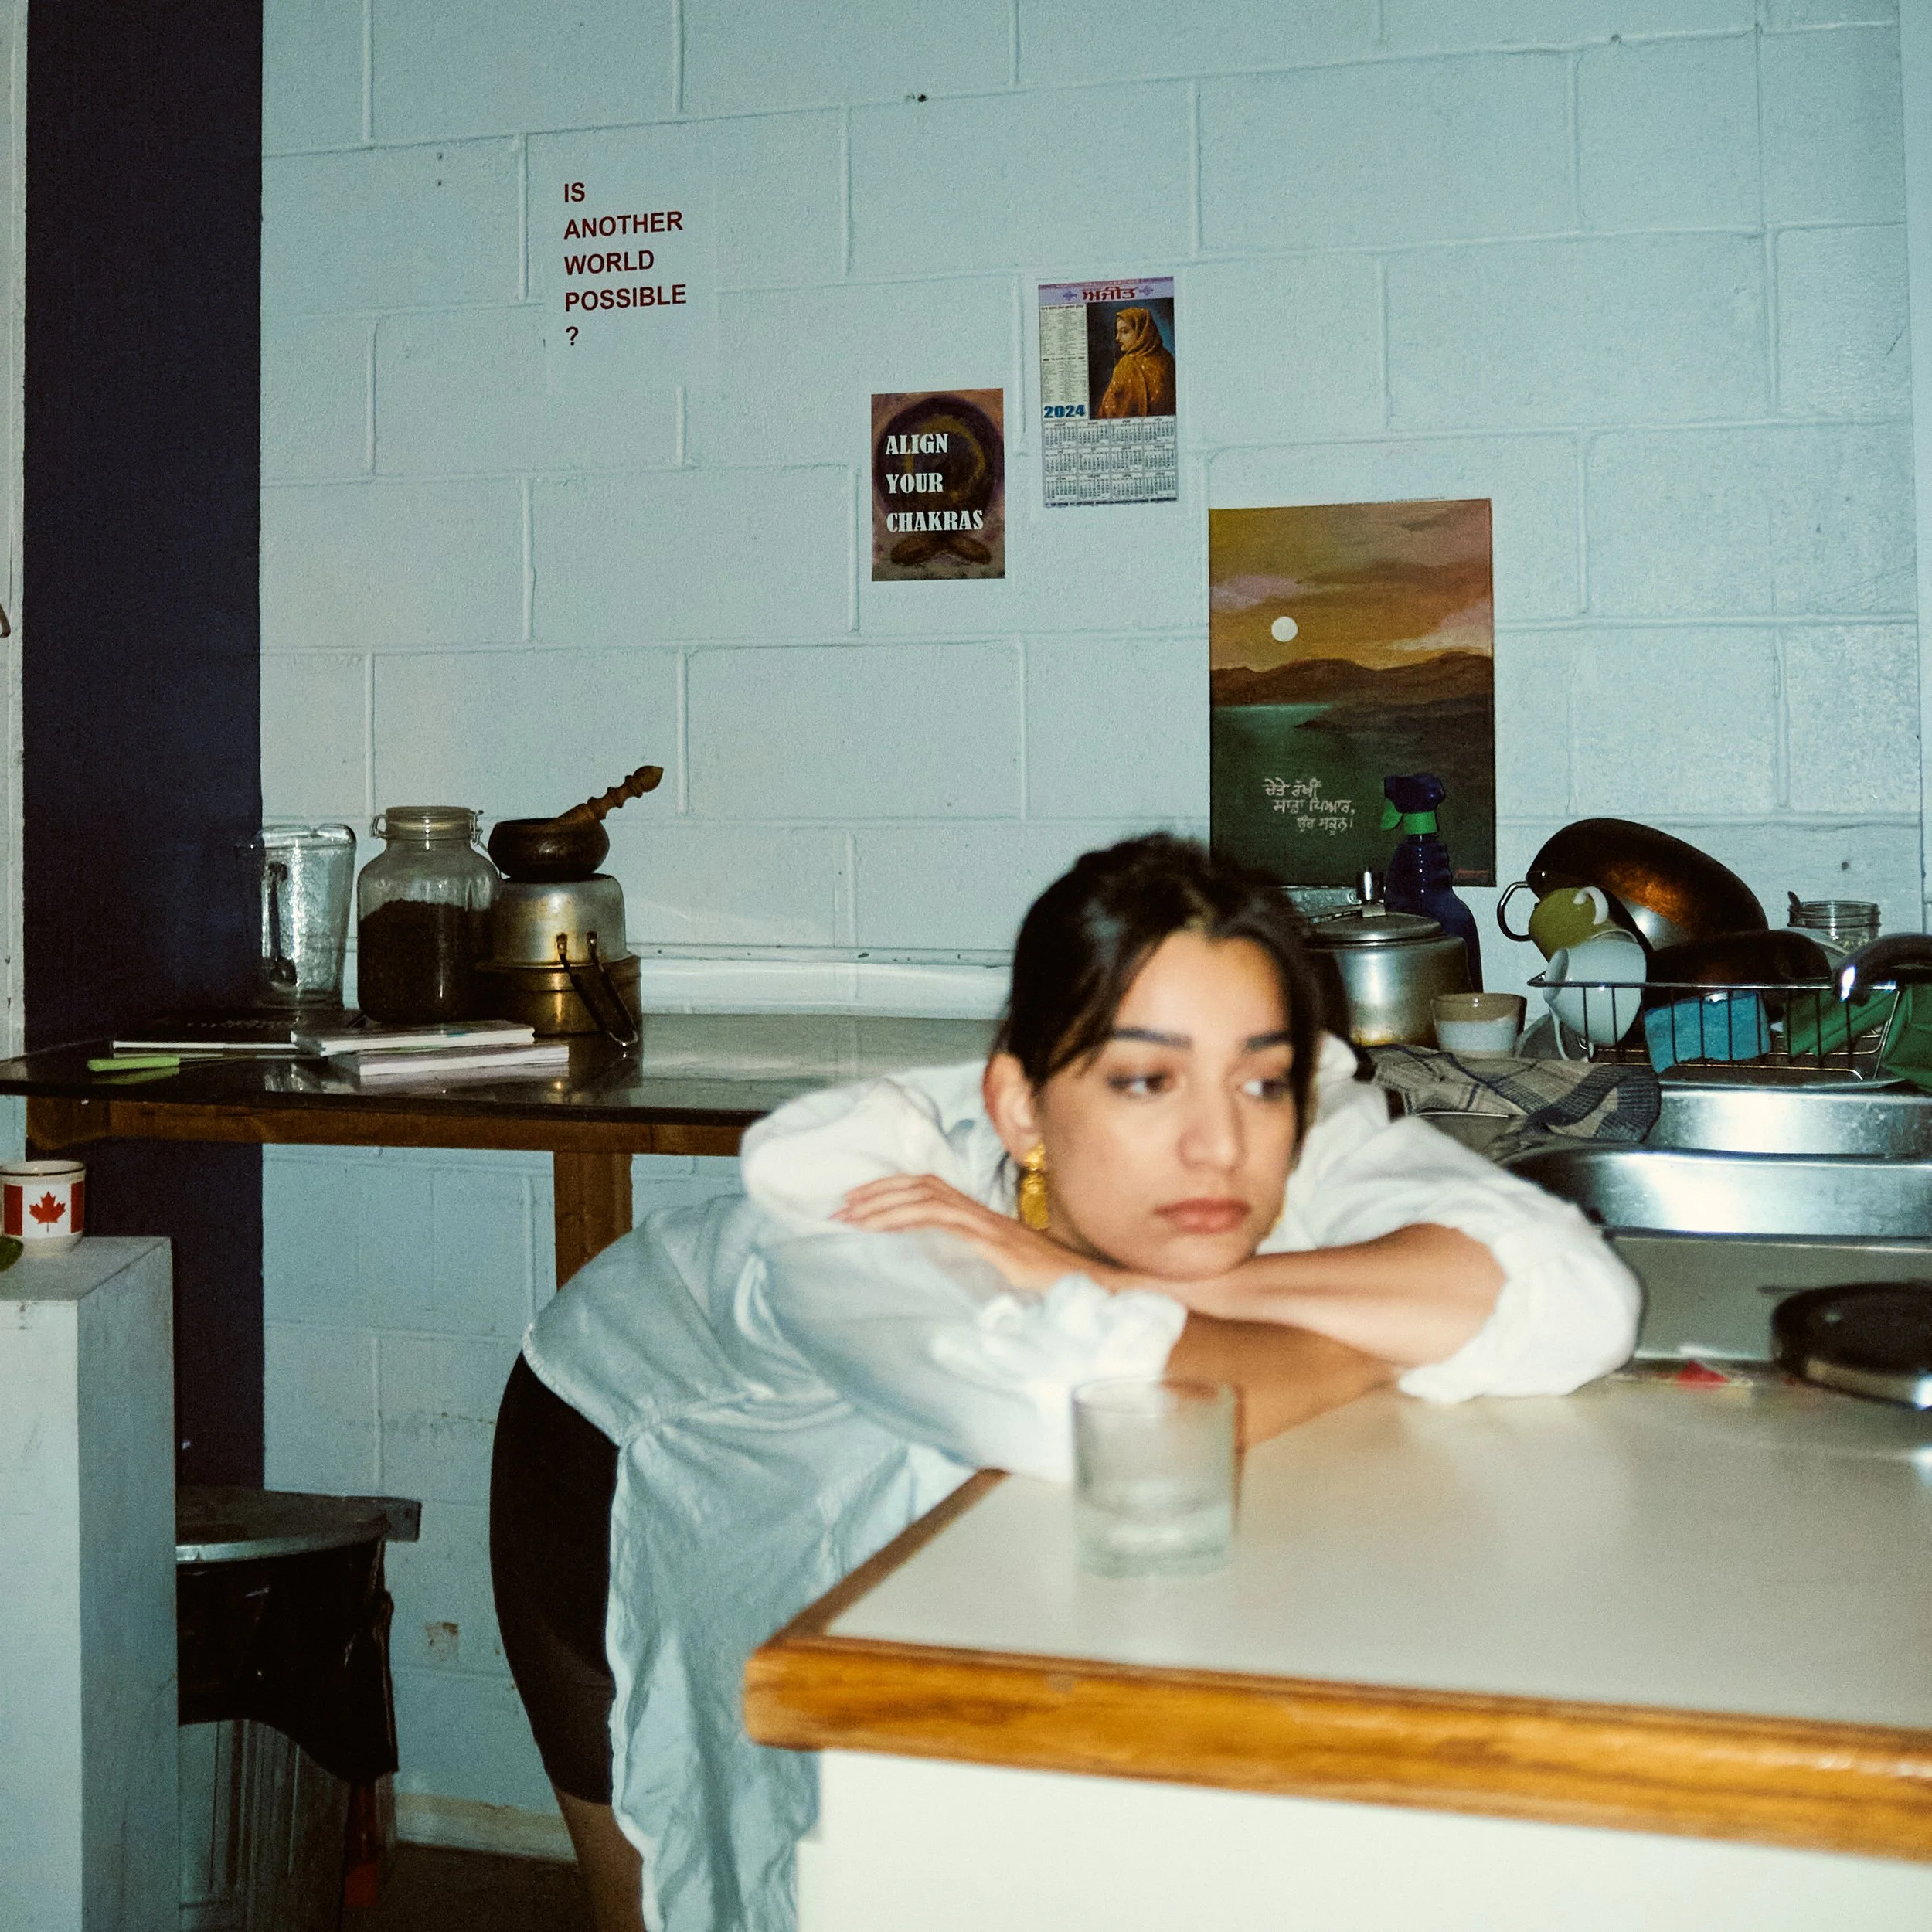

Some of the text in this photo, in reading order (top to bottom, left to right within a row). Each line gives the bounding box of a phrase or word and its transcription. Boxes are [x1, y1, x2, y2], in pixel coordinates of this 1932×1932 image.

[564, 182, 585, 202] IS
[563, 211, 683, 240] ANOTHER
[564, 250, 655, 275] WORLD
[565, 284, 686, 312] POSSIBLE
[1082, 286, 1139, 301] ਅਜੀਤ
[566, 326, 579, 346] ?
[1043, 404, 1085, 418] 2024
[885, 434, 948, 455] ALIGN
[886, 472, 944, 494] YOUR
[886, 510, 984, 532] CHAKRAS
